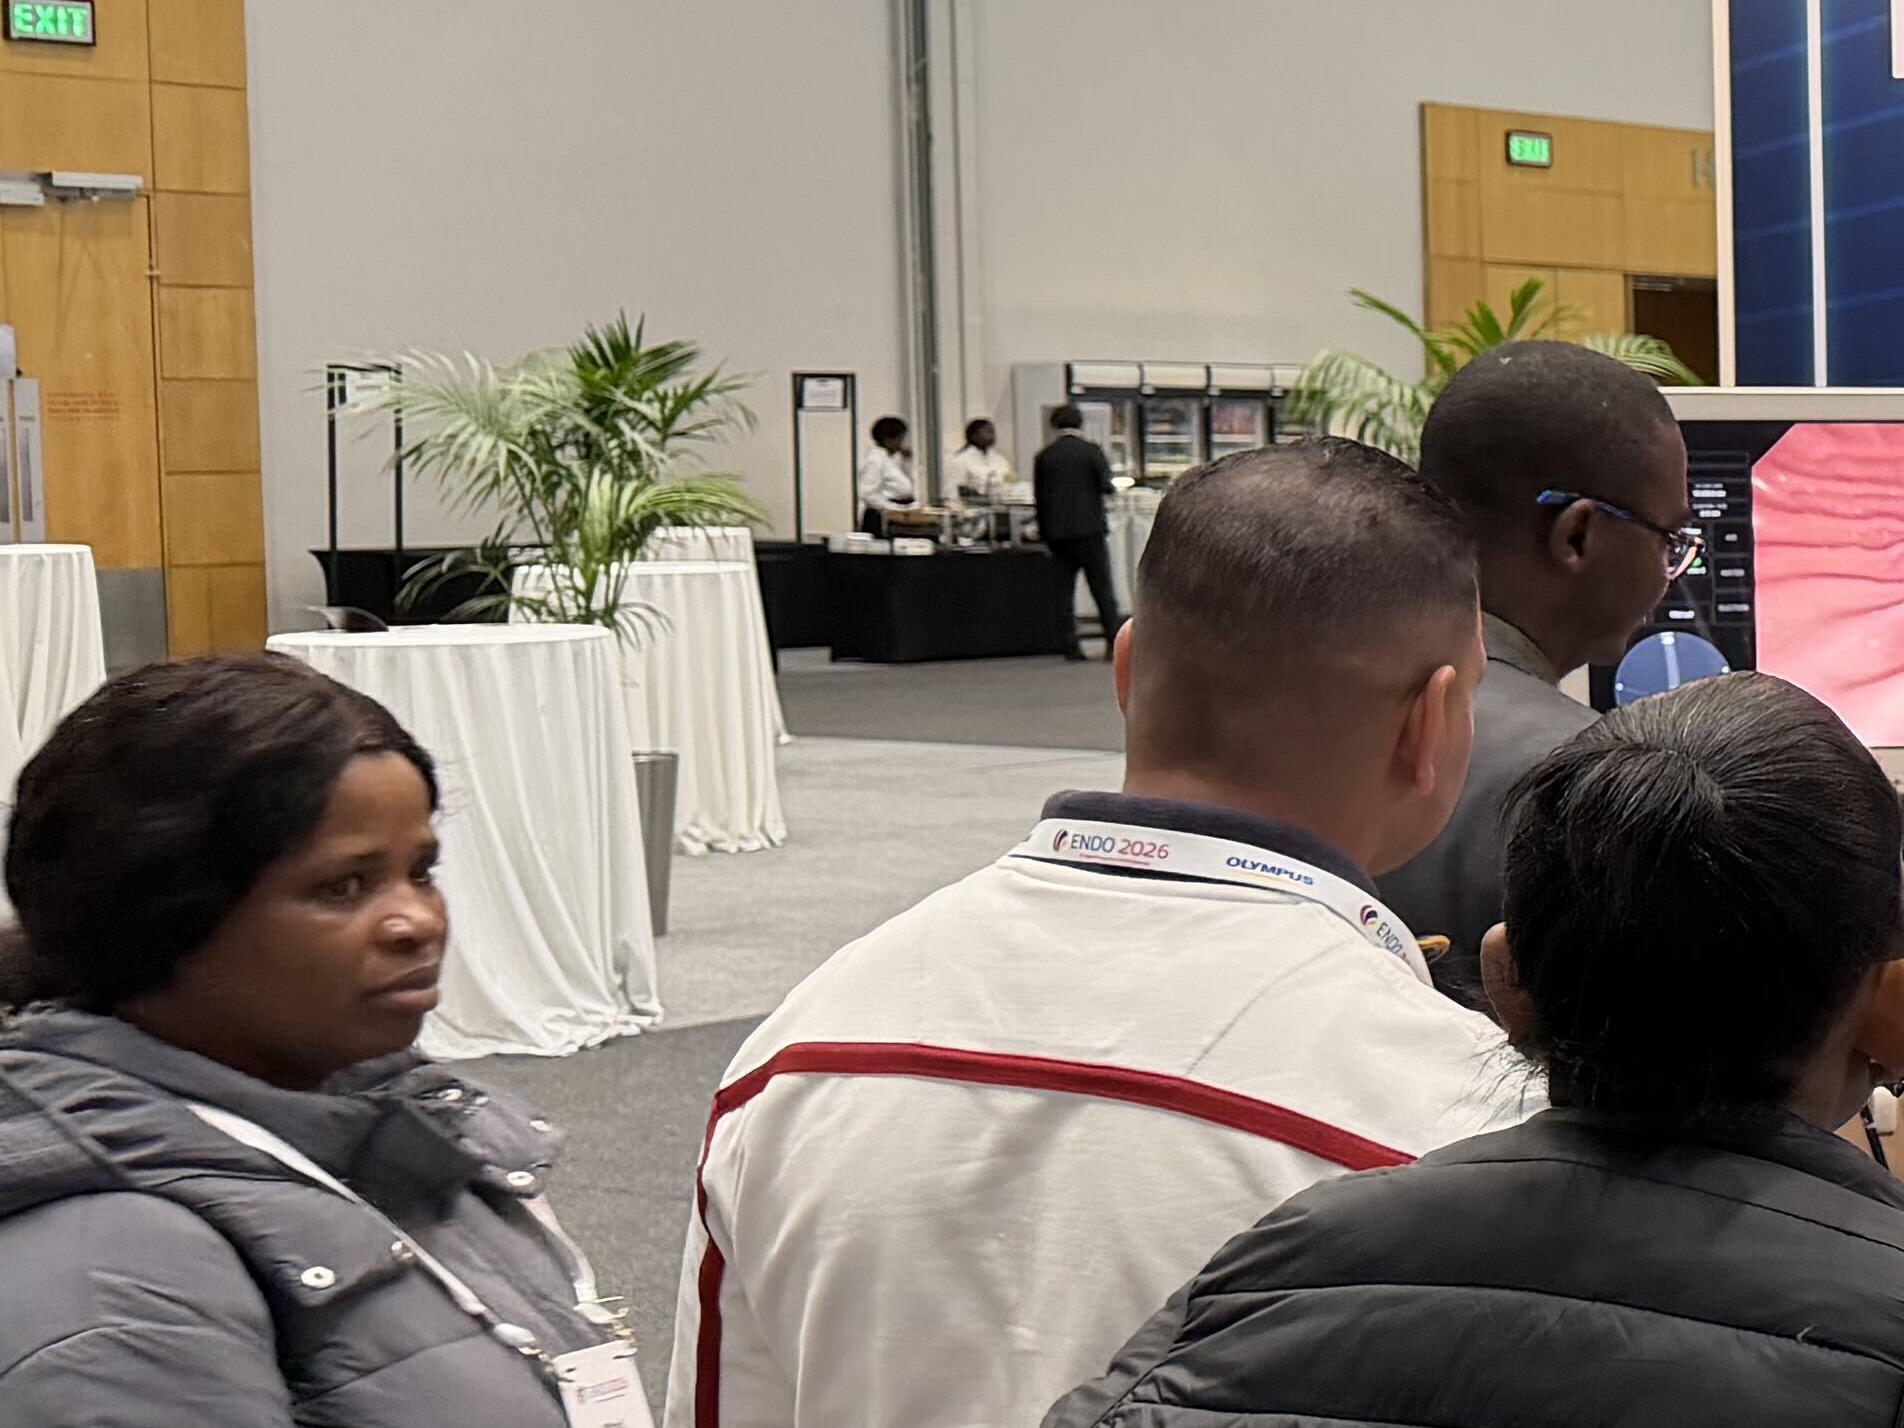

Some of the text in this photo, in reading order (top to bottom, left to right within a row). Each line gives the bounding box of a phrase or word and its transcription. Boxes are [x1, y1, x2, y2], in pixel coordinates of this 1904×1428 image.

[14, 3, 88, 37] EXIT
[1070, 833, 1115, 854] ENDO
[1117, 839, 1170, 860] 2026
[1225, 856, 1315, 886] OLYMPUS
